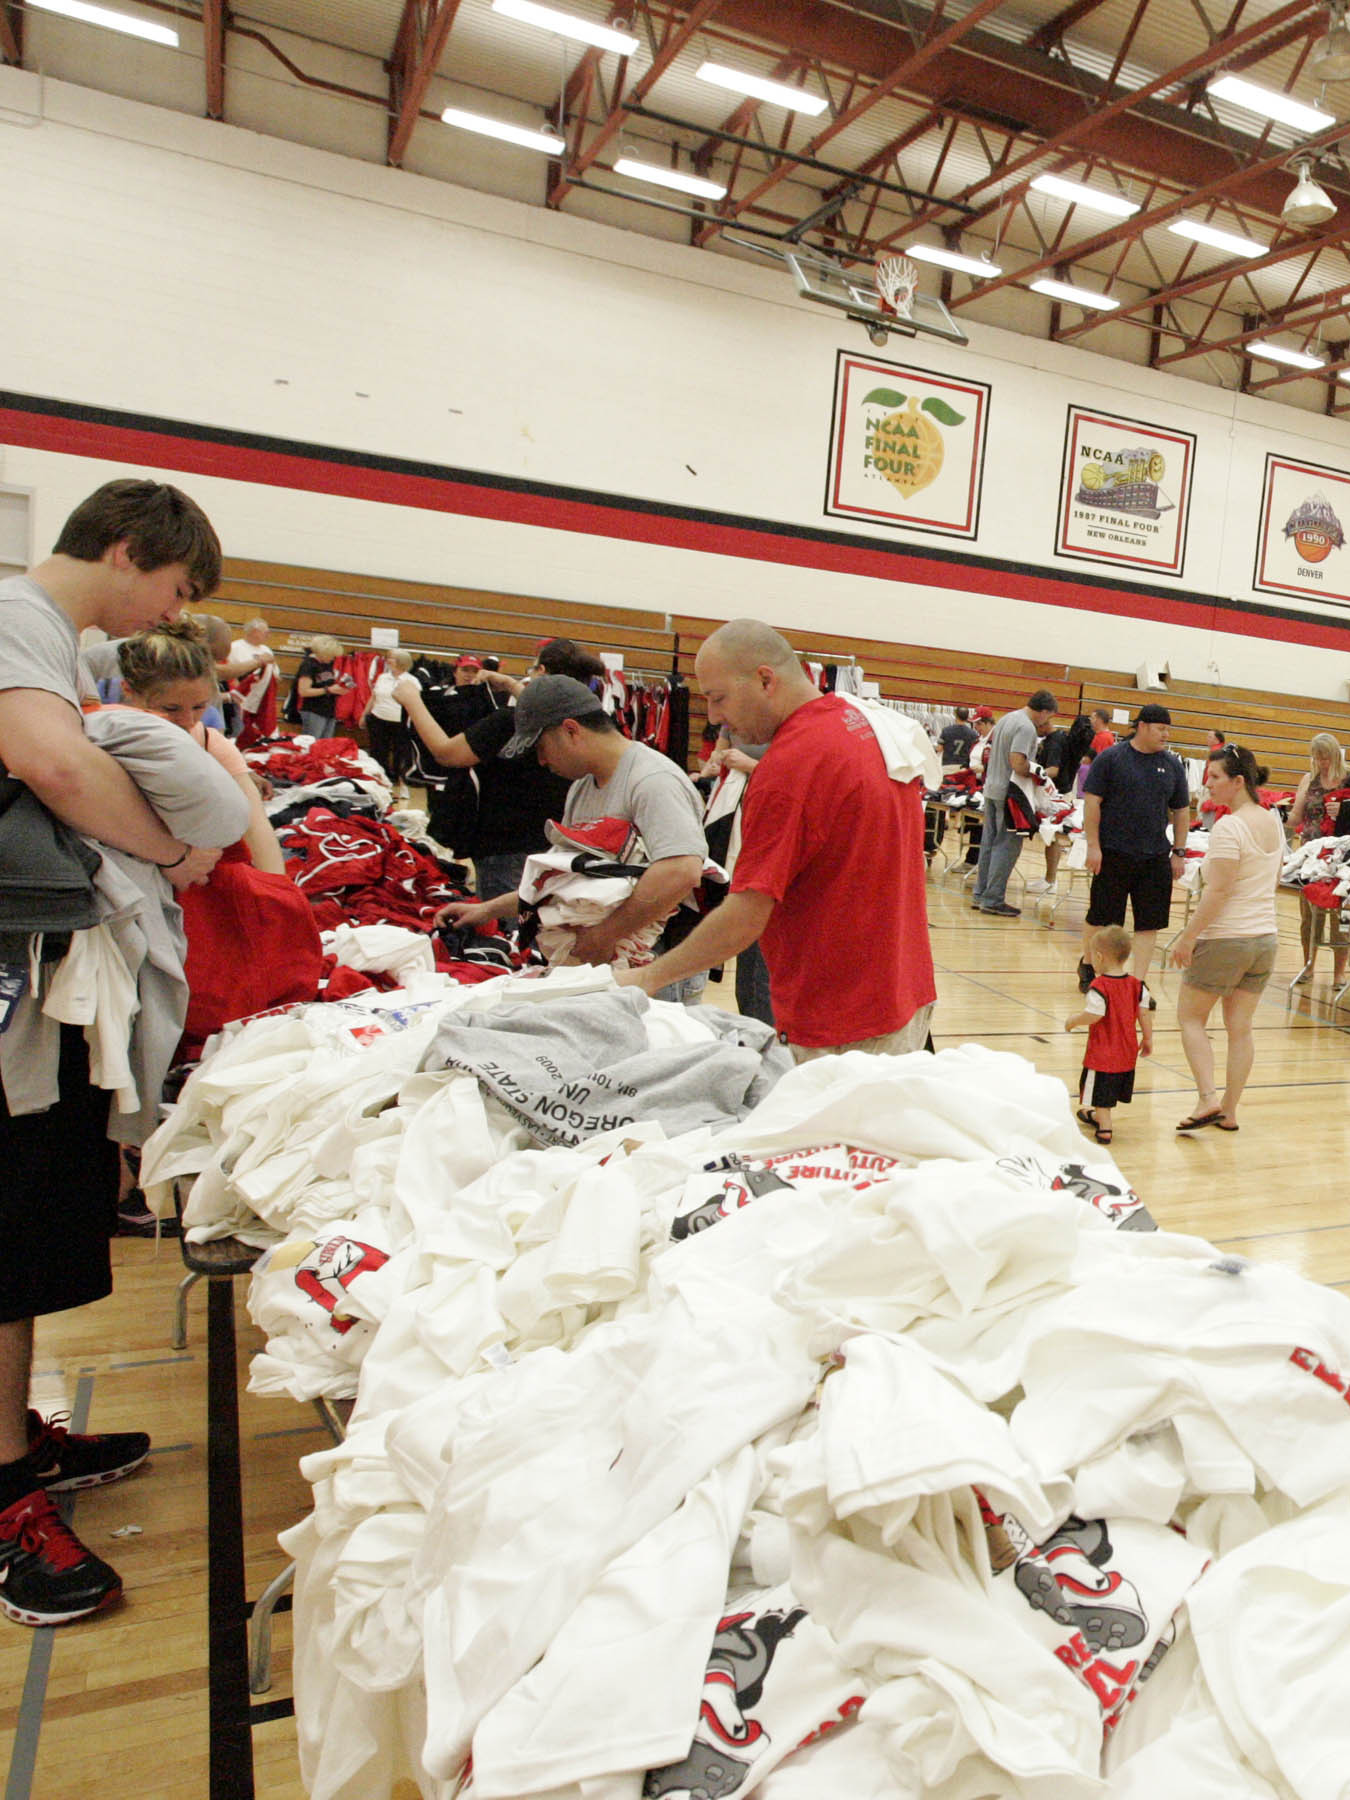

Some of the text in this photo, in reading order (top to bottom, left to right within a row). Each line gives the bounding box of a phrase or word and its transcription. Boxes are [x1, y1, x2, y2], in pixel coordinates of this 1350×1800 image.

[866, 417, 921, 439] NCAA
[865, 435, 921, 459] FINAL
[1081, 445, 1124, 465] NCAA
[864, 454, 917, 477] FOUR
[1073, 510, 1160, 534] 1987 FINAL FOUR
[1087, 530, 1147, 547] NEW ORLEANS
[1302, 532, 1325, 545] 1990
[1297, 567, 1324, 579] DENVER
[953, 739, 965, 756] 7
[535, 1055, 564, 1082] 2009
